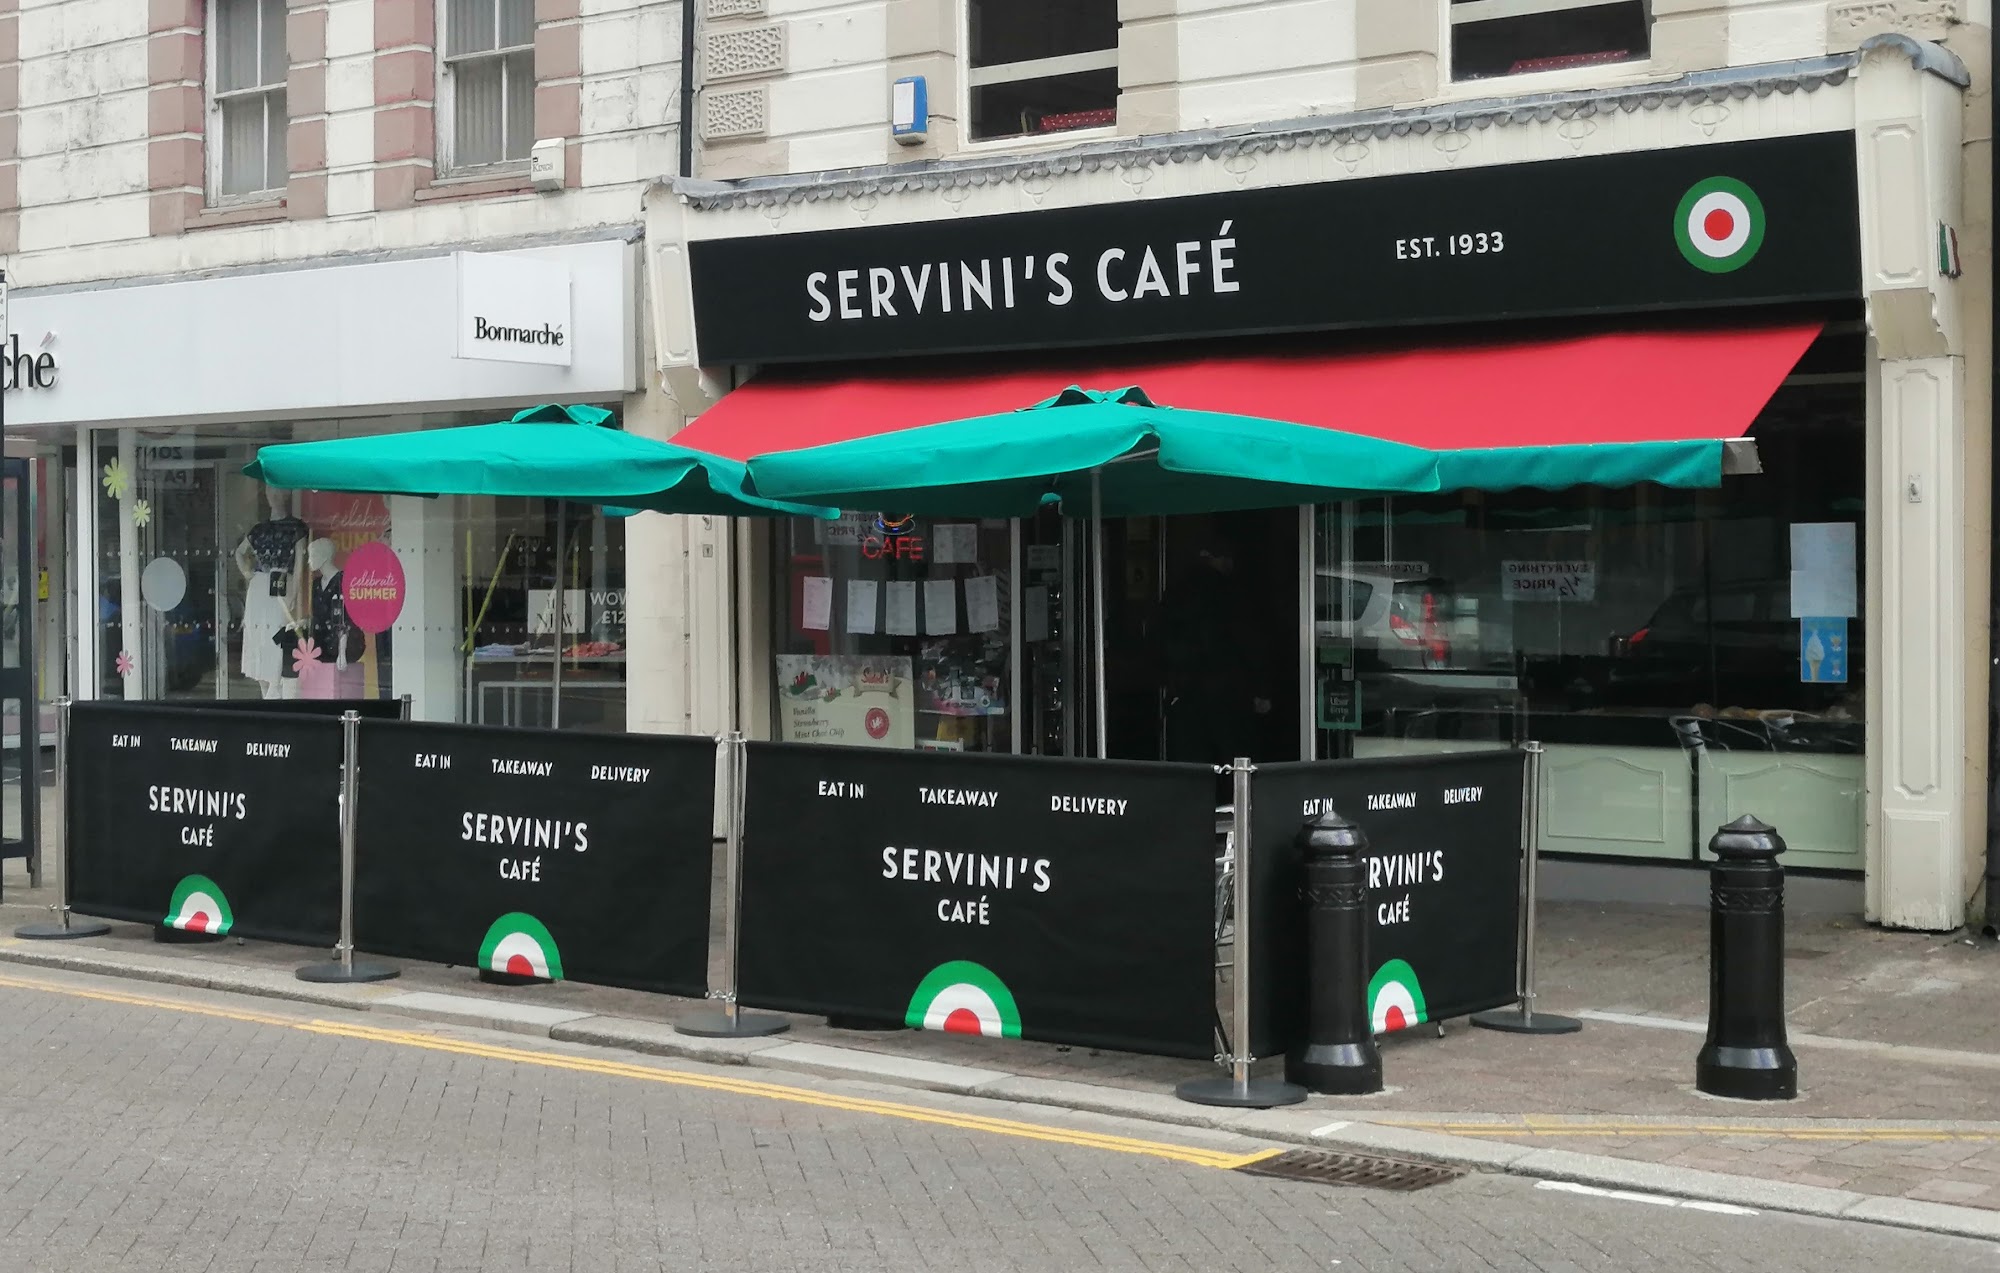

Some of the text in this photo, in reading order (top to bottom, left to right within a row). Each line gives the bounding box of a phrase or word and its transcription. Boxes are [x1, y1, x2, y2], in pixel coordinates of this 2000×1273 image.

[1396, 232, 1504, 259] EST. 1933
[807, 220, 1239, 321] SERVINI'S CAFÉ
[474, 316, 564, 346] Bonmarché
[863, 537, 924, 560] CAFE
[350, 570, 398, 588] celebrate
[349, 588, 397, 600] SUMMER
[113, 735, 140, 747] EAT IN
[171, 738, 218, 752] TAKEAWAY
[246, 743, 290, 757] DELIVERY
[415, 754, 450, 769] EAT IN
[492, 759, 552, 776] TAKEAWAY
[591, 765, 650, 782] DELIVERY
[819, 781, 863, 798] EAT IN
[920, 788, 998, 807] TAKEAWAY
[1444, 787, 1482, 804] DELIVERY
[149, 785, 245, 819] SERVINI'S
[1052, 796, 1127, 815] DELIVERY
[1304, 798, 1333, 815] EAT IN
[1368, 792, 1416, 810] TAKEAWAY
[182, 824, 213, 847] CAFÉ
[462, 812, 587, 852] SERVINI'S
[500, 856, 540, 882] CAFÉ
[883, 847, 1050, 892] SERVINI'S
[1362, 850, 1443, 888] RVINI'S
[938, 895, 989, 925] CAFÉ
[1378, 894, 1409, 925] CAFÉ
